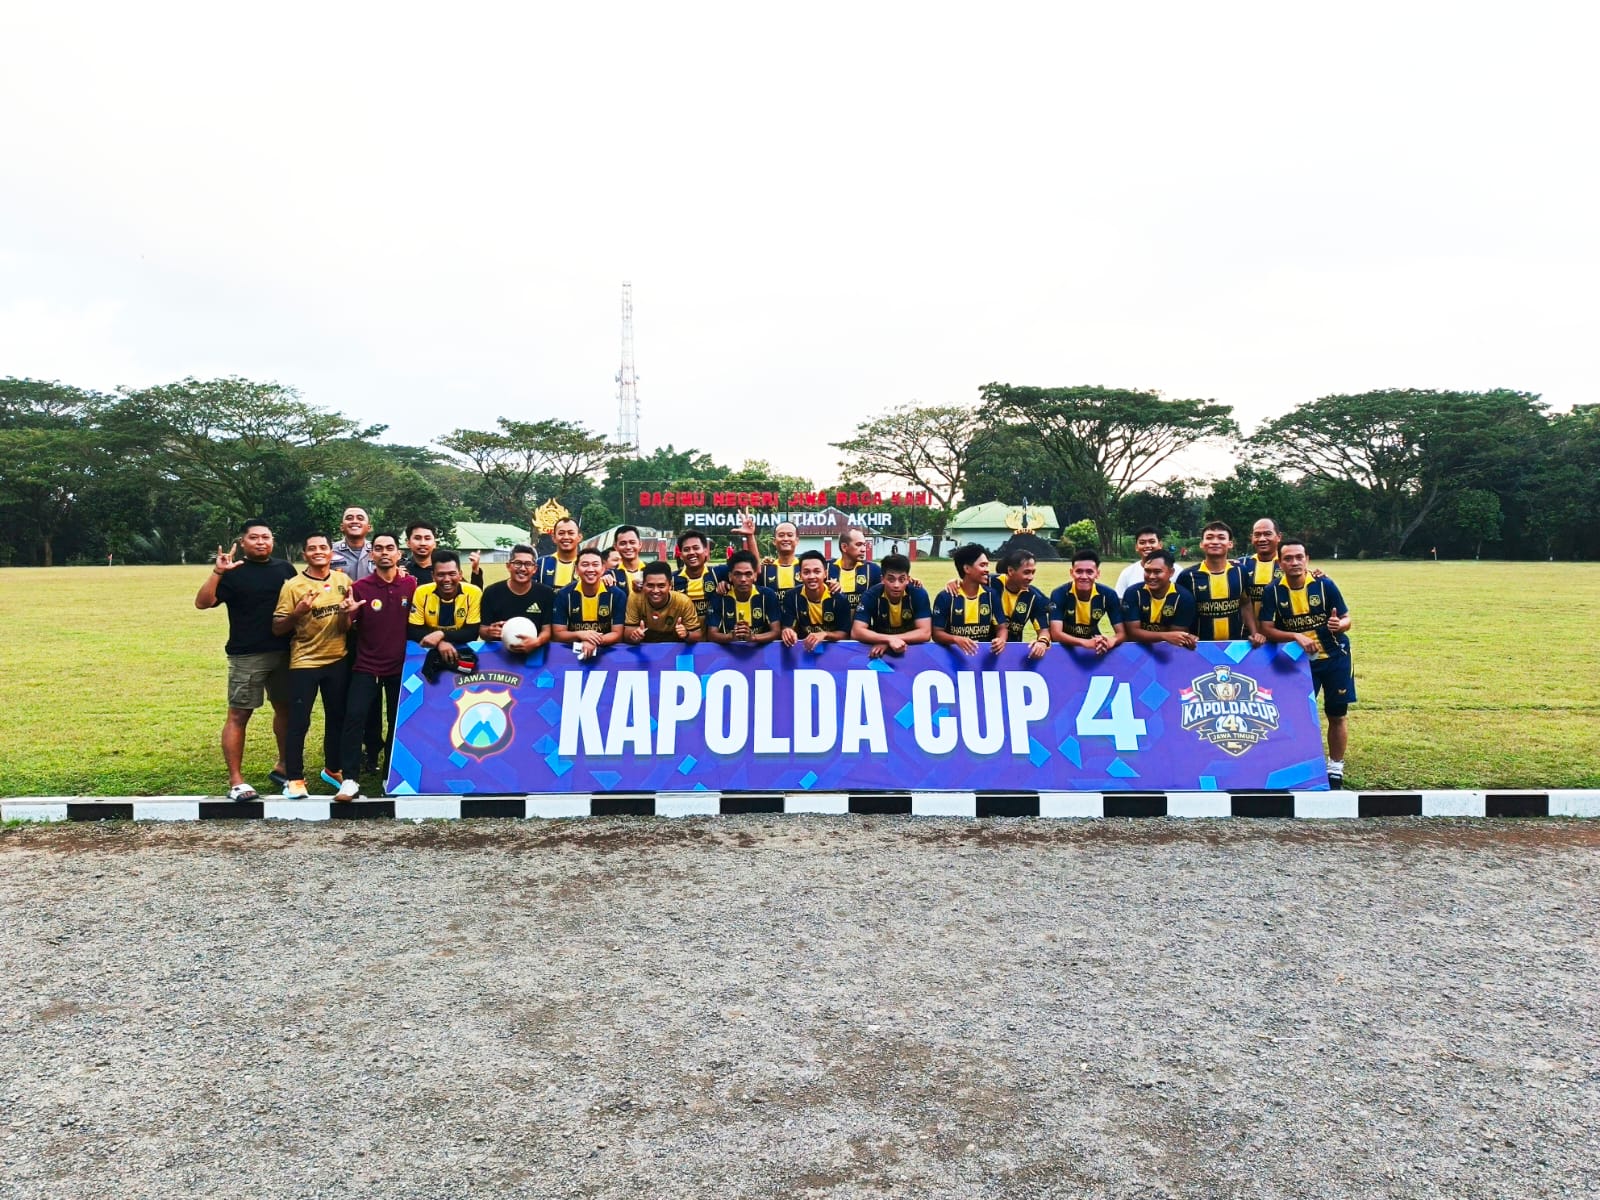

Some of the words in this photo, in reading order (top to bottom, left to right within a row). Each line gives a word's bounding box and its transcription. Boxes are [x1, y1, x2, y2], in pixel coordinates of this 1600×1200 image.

[712, 491, 779, 507] NEGERI
[788, 491, 828, 507] JIWA
[836, 491, 883, 507] RAGA
[794, 513, 837, 526] TIADA
[847, 513, 892, 526] AKHIR
[458, 673, 486, 685] JAWA
[487, 673, 519, 685] TIMUR
[558, 669, 889, 756] KAPOLDA
[911, 669, 1050, 755] CUP
[1075, 675, 1147, 752] 4
[1183, 701, 1278, 726] KAPOLDACUP
[1221, 714, 1239, 732] 4
[1212, 732, 1232, 741] JAWA
[1233, 732, 1256, 741] TIMUR
